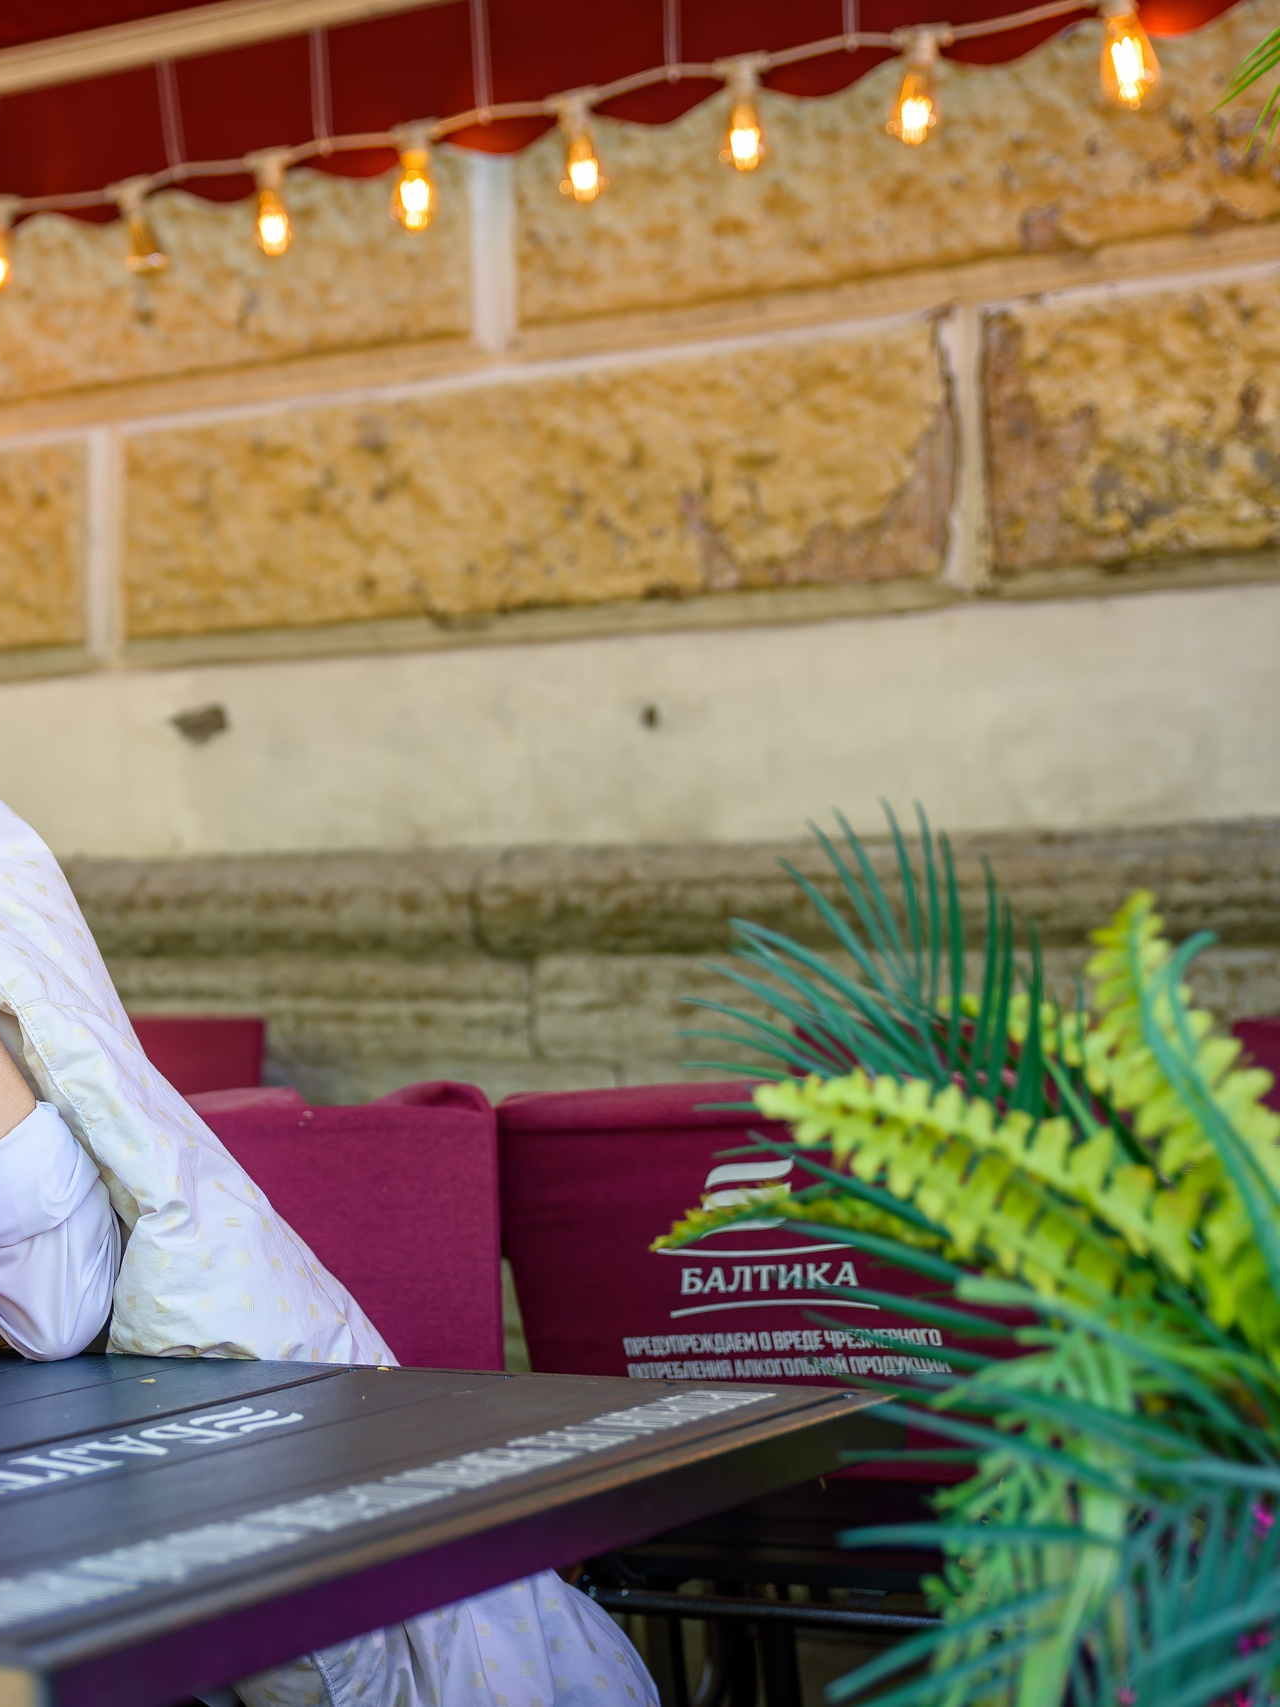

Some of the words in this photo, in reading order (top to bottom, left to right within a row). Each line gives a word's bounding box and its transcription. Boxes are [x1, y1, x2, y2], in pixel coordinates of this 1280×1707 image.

[680, 1261, 860, 1295] БАЛТИКА
[622, 1332, 757, 1357] ПРЕДУПРЕЖДАЕМ
[771, 1330, 824, 1352] ВРЕДЕ
[627, 1360, 733, 1379] ПОТРЕБЛЕНИЯ
[734, 1353, 850, 1379] АЛКОГОЛЬНОЙ
